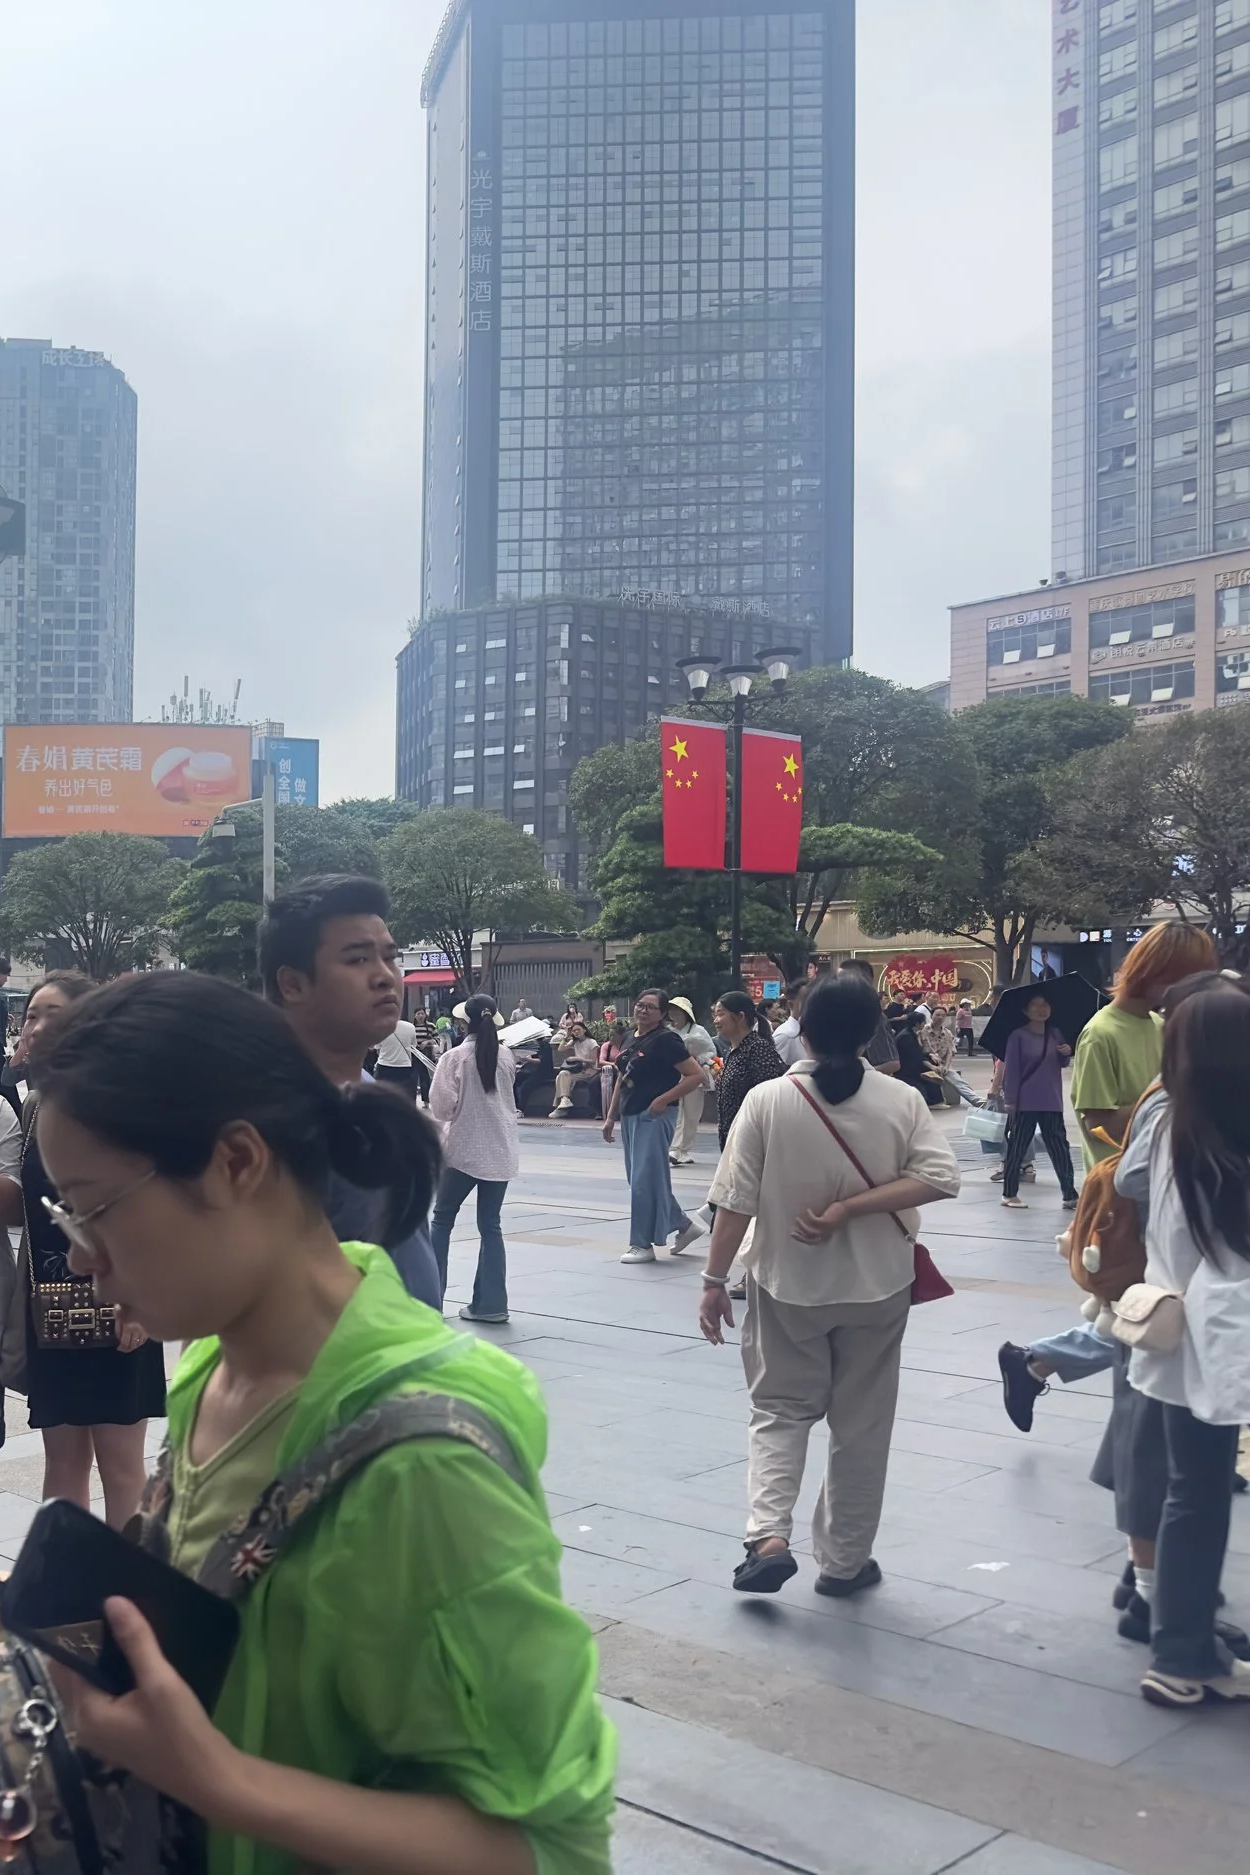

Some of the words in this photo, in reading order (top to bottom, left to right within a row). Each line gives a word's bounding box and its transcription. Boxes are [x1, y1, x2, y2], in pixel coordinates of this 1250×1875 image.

[469, 168, 493, 332] 光宇戴斯酒店
[45, 779, 113, 798] 养出好气色
